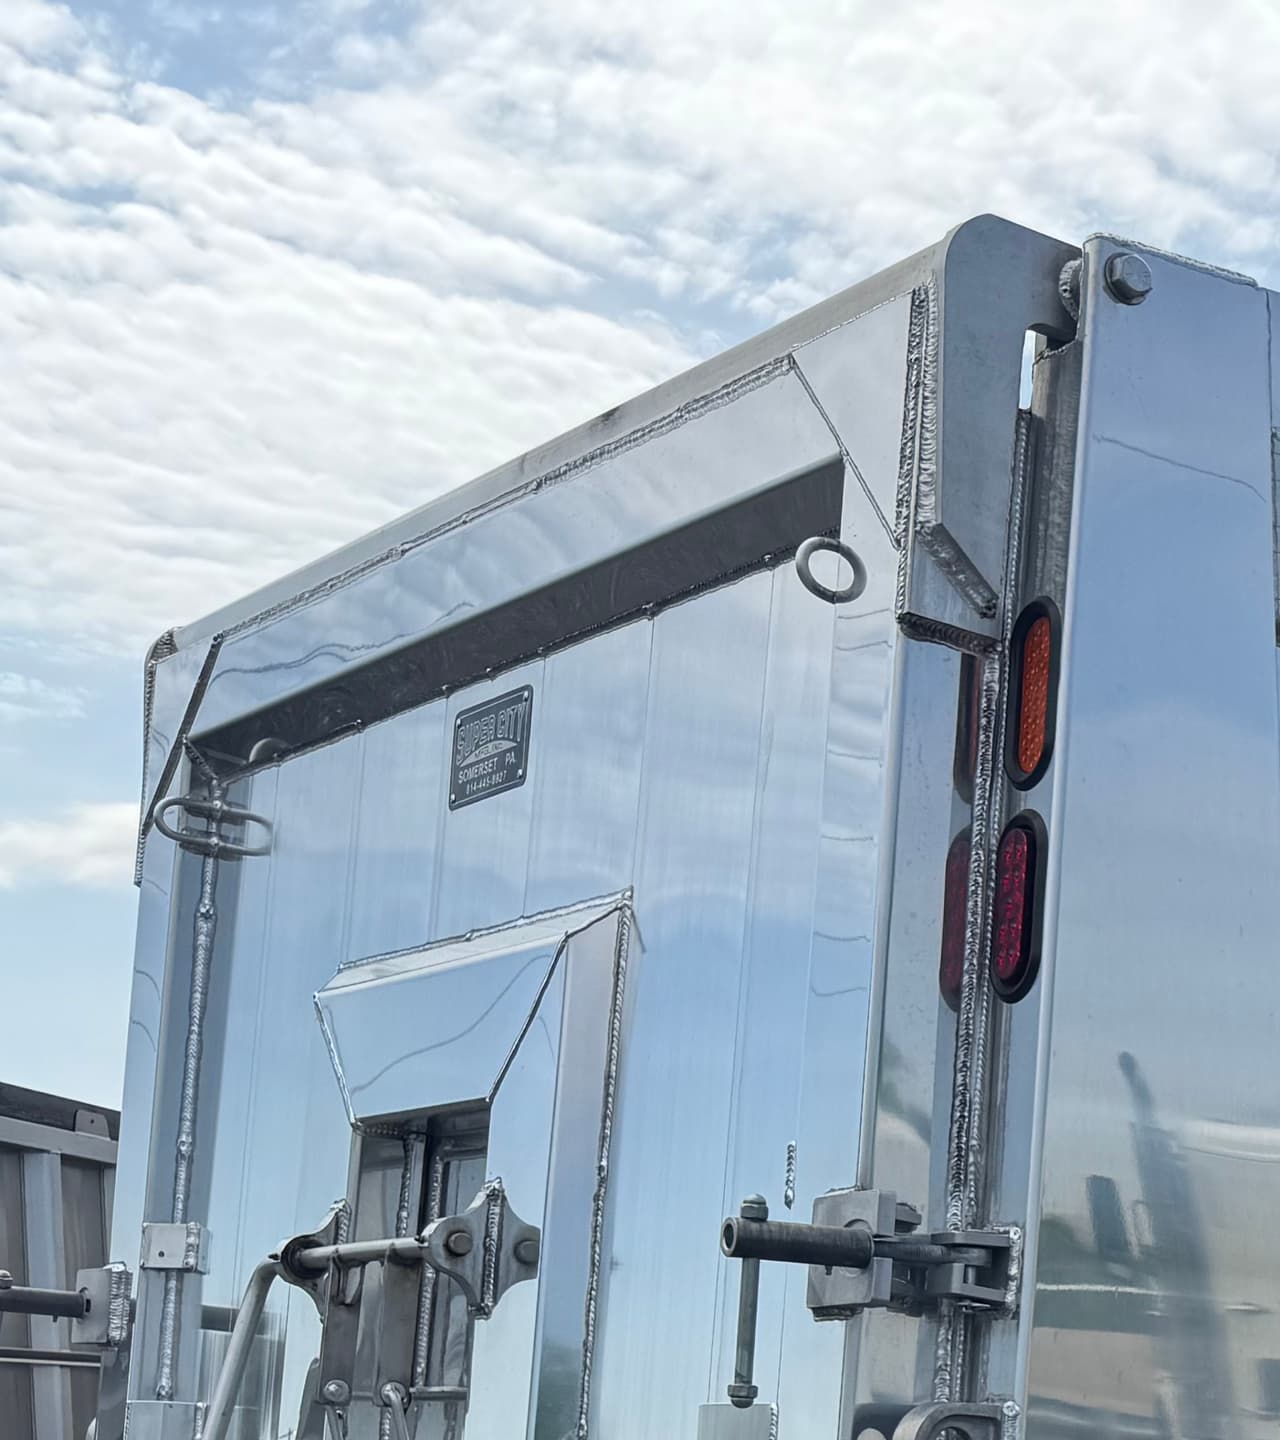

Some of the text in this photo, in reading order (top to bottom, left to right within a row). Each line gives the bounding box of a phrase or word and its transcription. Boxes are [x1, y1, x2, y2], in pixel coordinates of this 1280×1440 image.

[456, 702, 528, 765] SUPER CITY
[458, 757, 498, 784] SOMERSET
